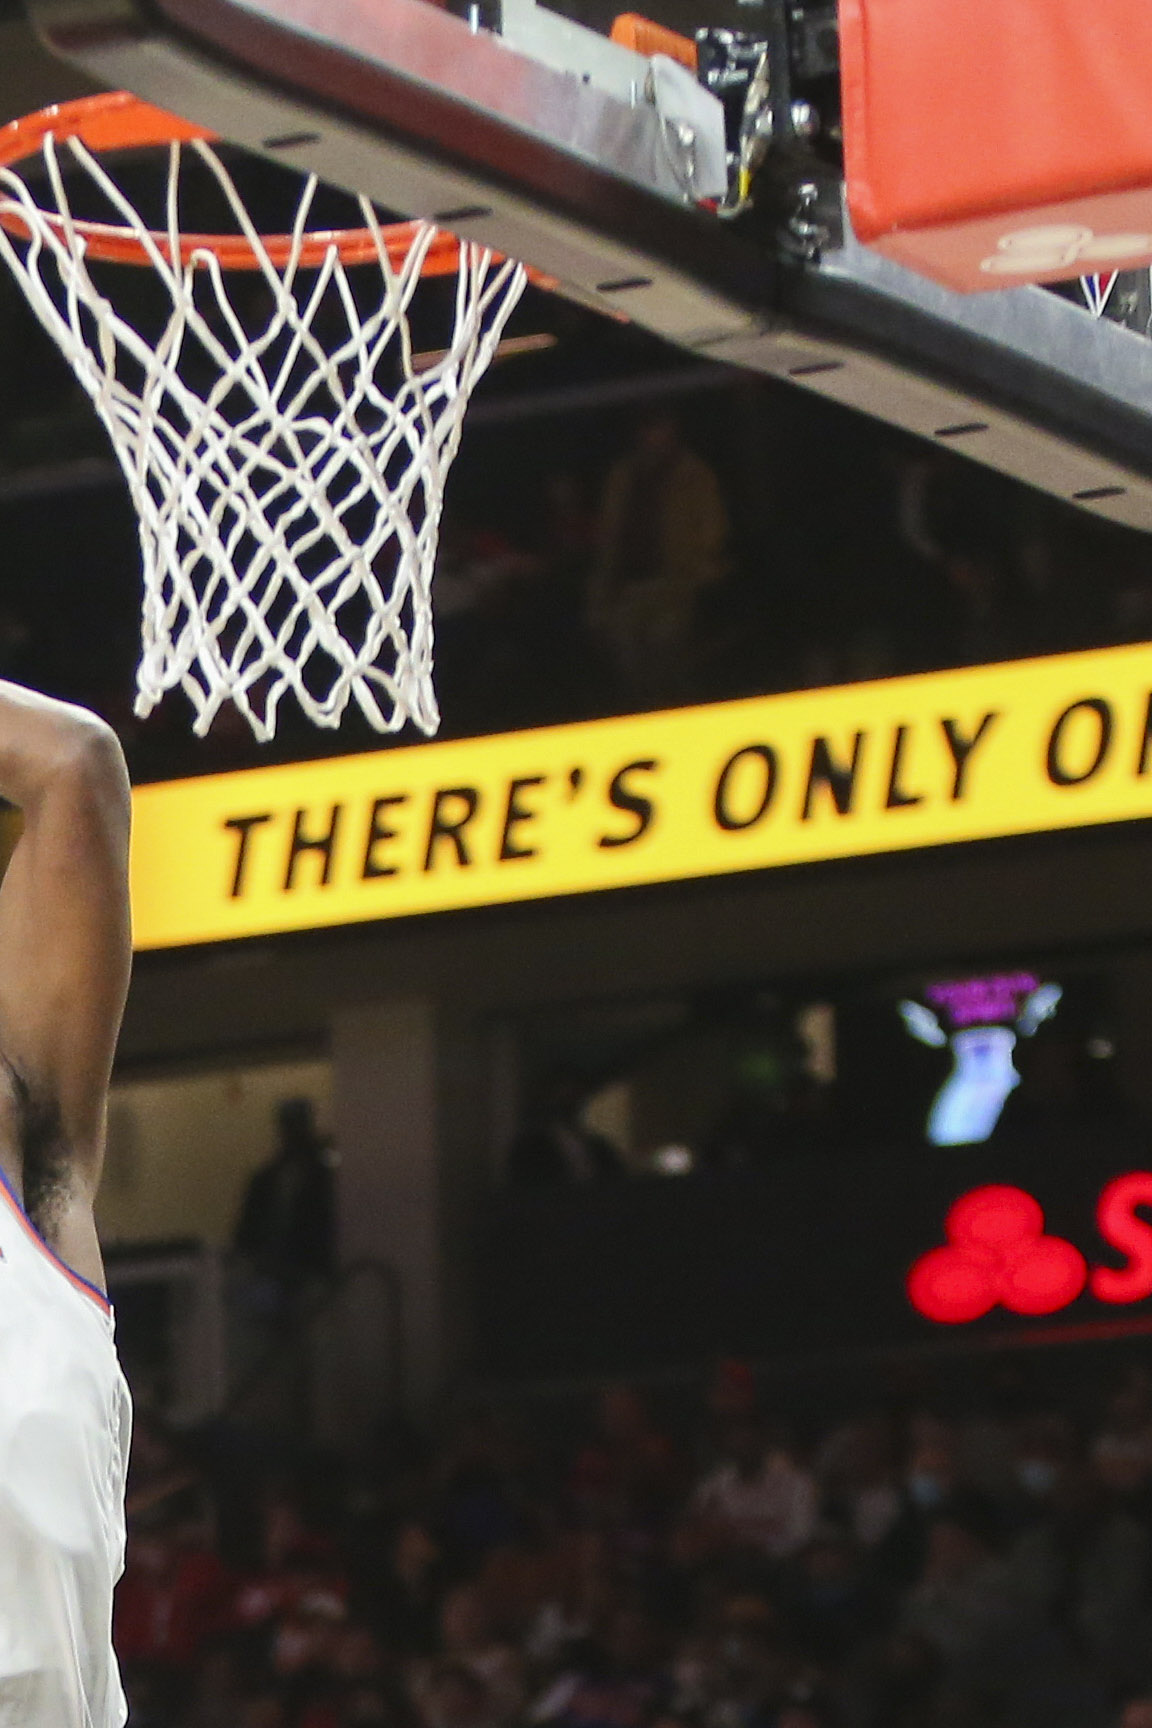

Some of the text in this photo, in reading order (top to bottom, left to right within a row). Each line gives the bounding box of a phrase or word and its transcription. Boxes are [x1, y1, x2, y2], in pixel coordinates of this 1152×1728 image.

[222, 690, 1152, 899] THERE'S ONLY O
